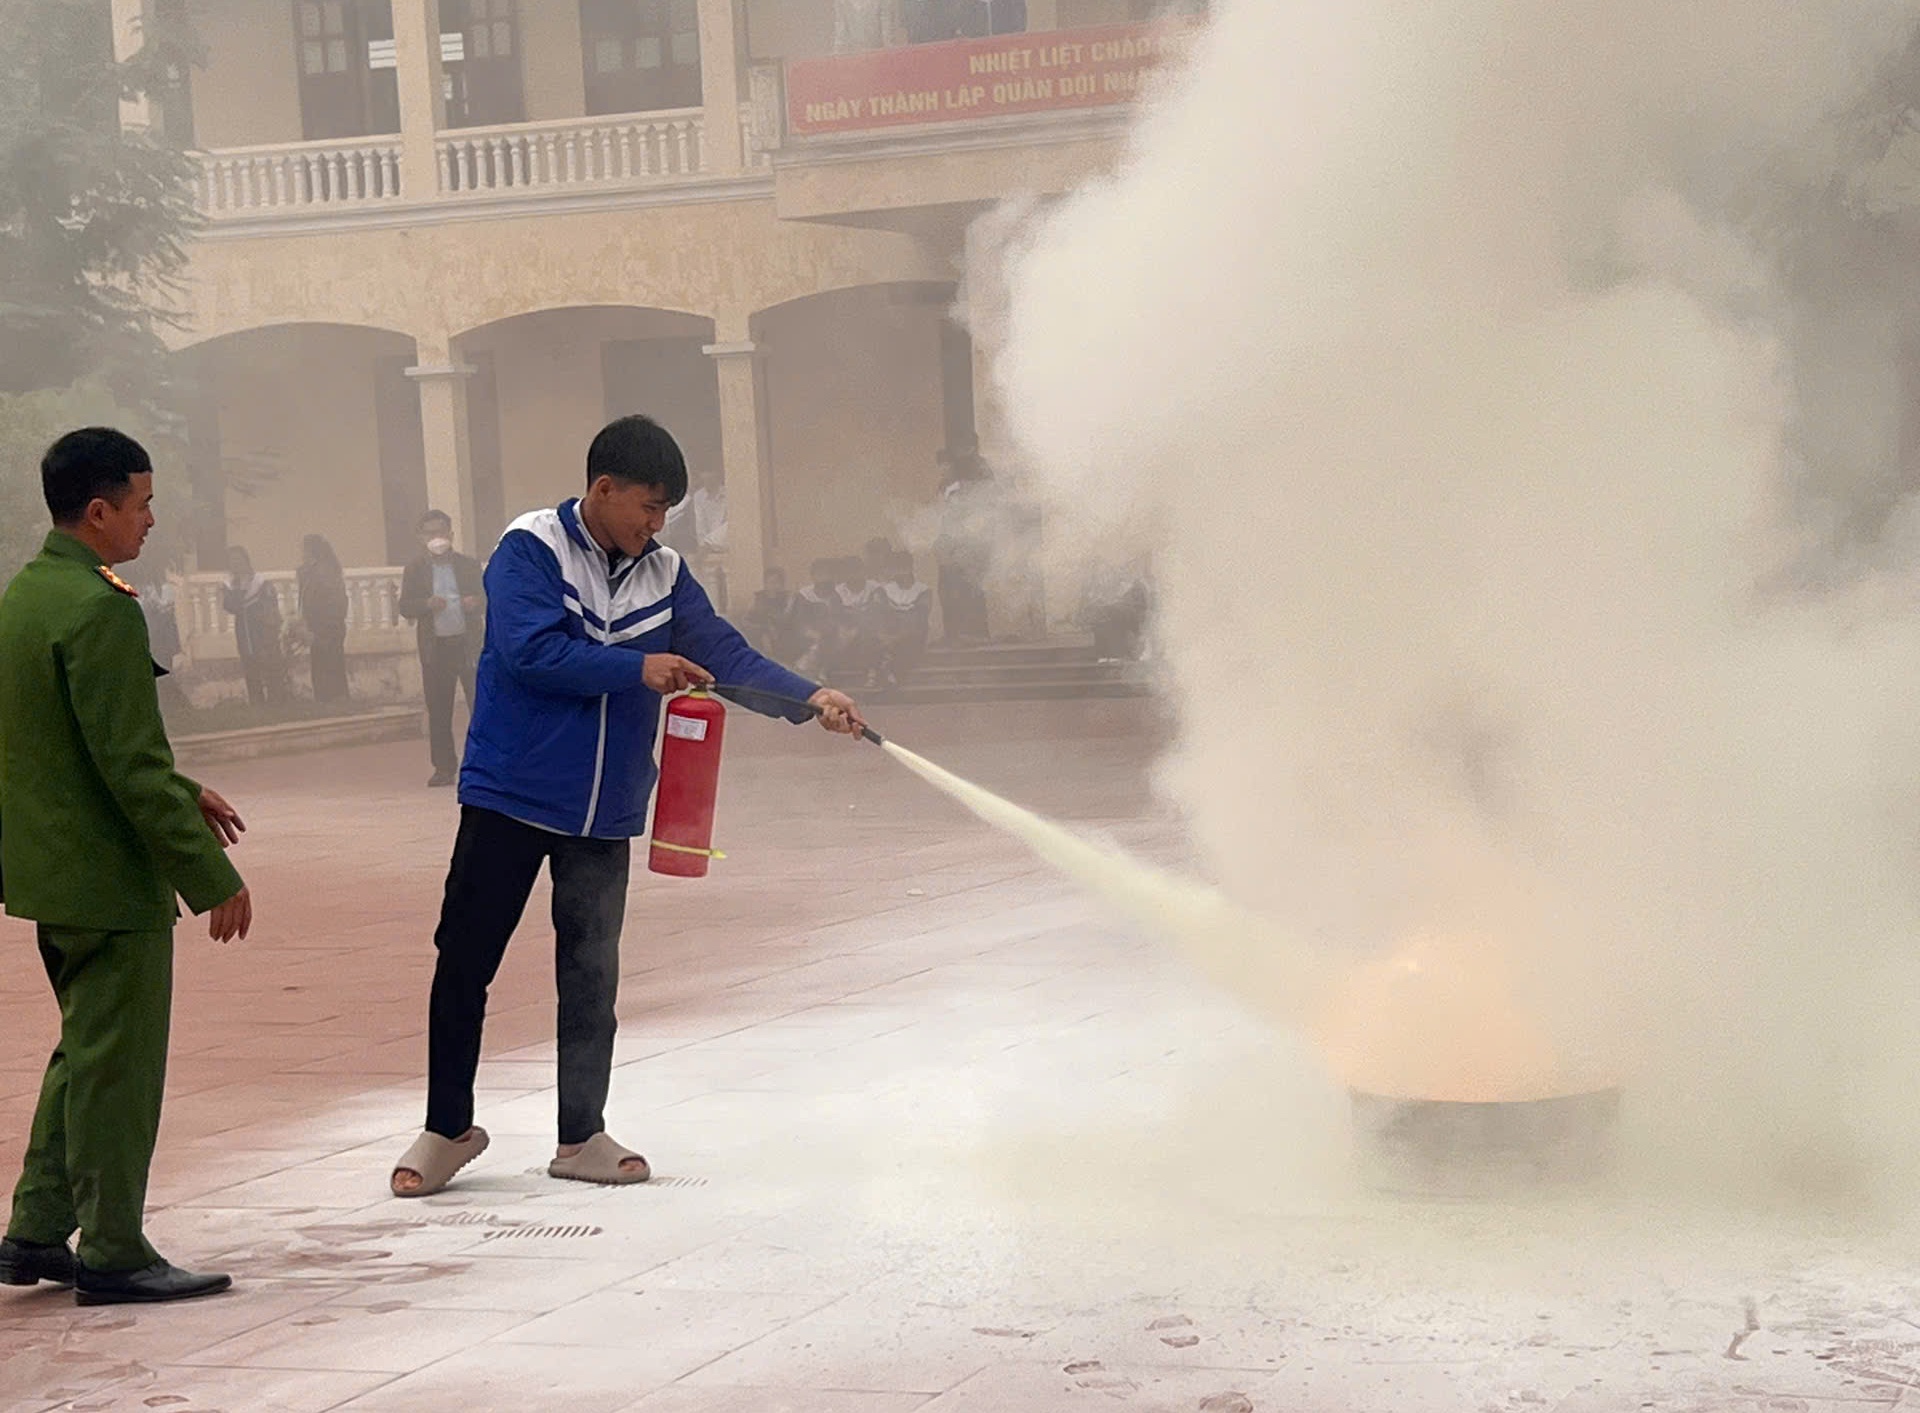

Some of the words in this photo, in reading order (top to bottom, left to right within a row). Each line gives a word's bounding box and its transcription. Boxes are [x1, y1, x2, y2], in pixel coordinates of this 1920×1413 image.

[969, 48, 1032, 75] NHIỆT
[1039, 42, 1084, 70] LIỆT
[806, 95, 862, 122] NGÀY
[868, 89, 939, 116] THÀNH
[993, 77, 1053, 104] QUÂN
